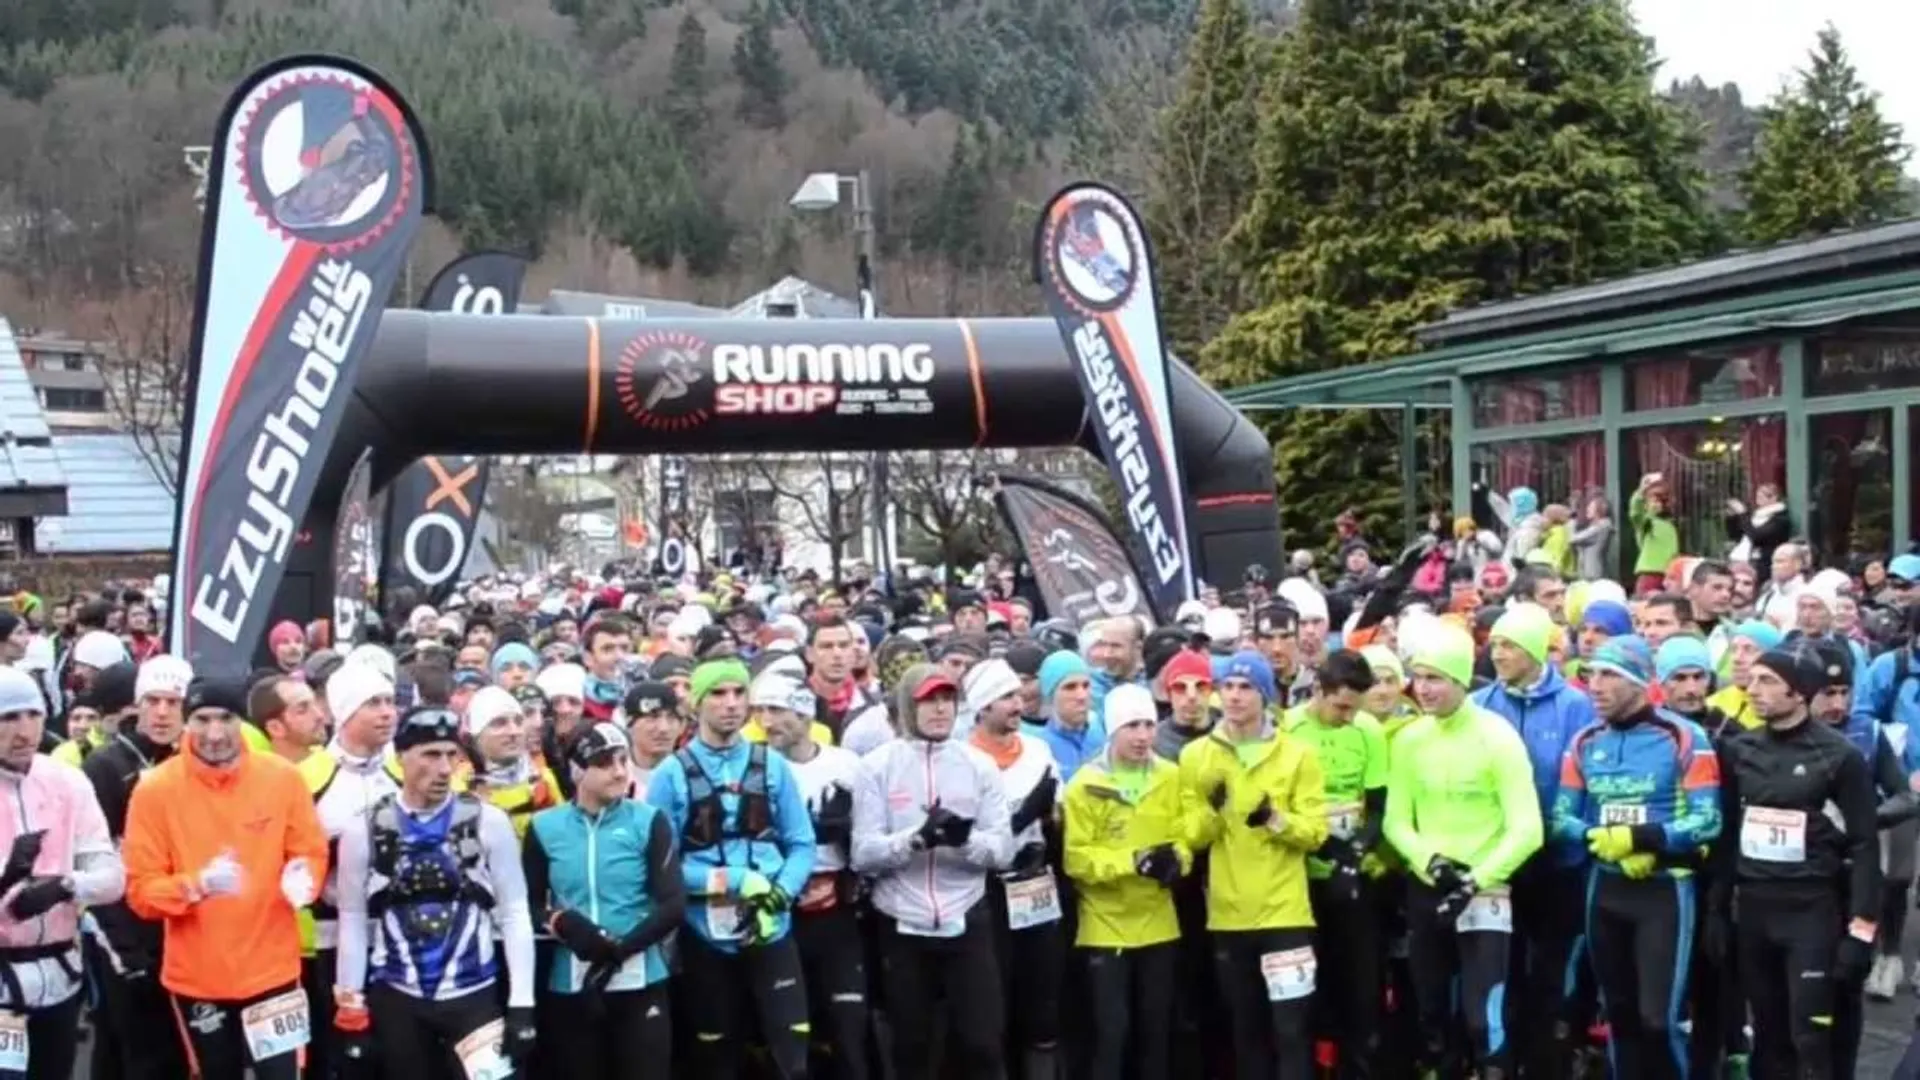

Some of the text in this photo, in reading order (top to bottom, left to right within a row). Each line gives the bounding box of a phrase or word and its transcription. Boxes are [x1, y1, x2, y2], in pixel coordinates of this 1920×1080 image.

[288, 258, 342, 349] Walk
[712, 343, 935, 384] RUNNING
[715, 385, 836, 414] SHOP
[191, 260, 372, 643] EzyShoes
